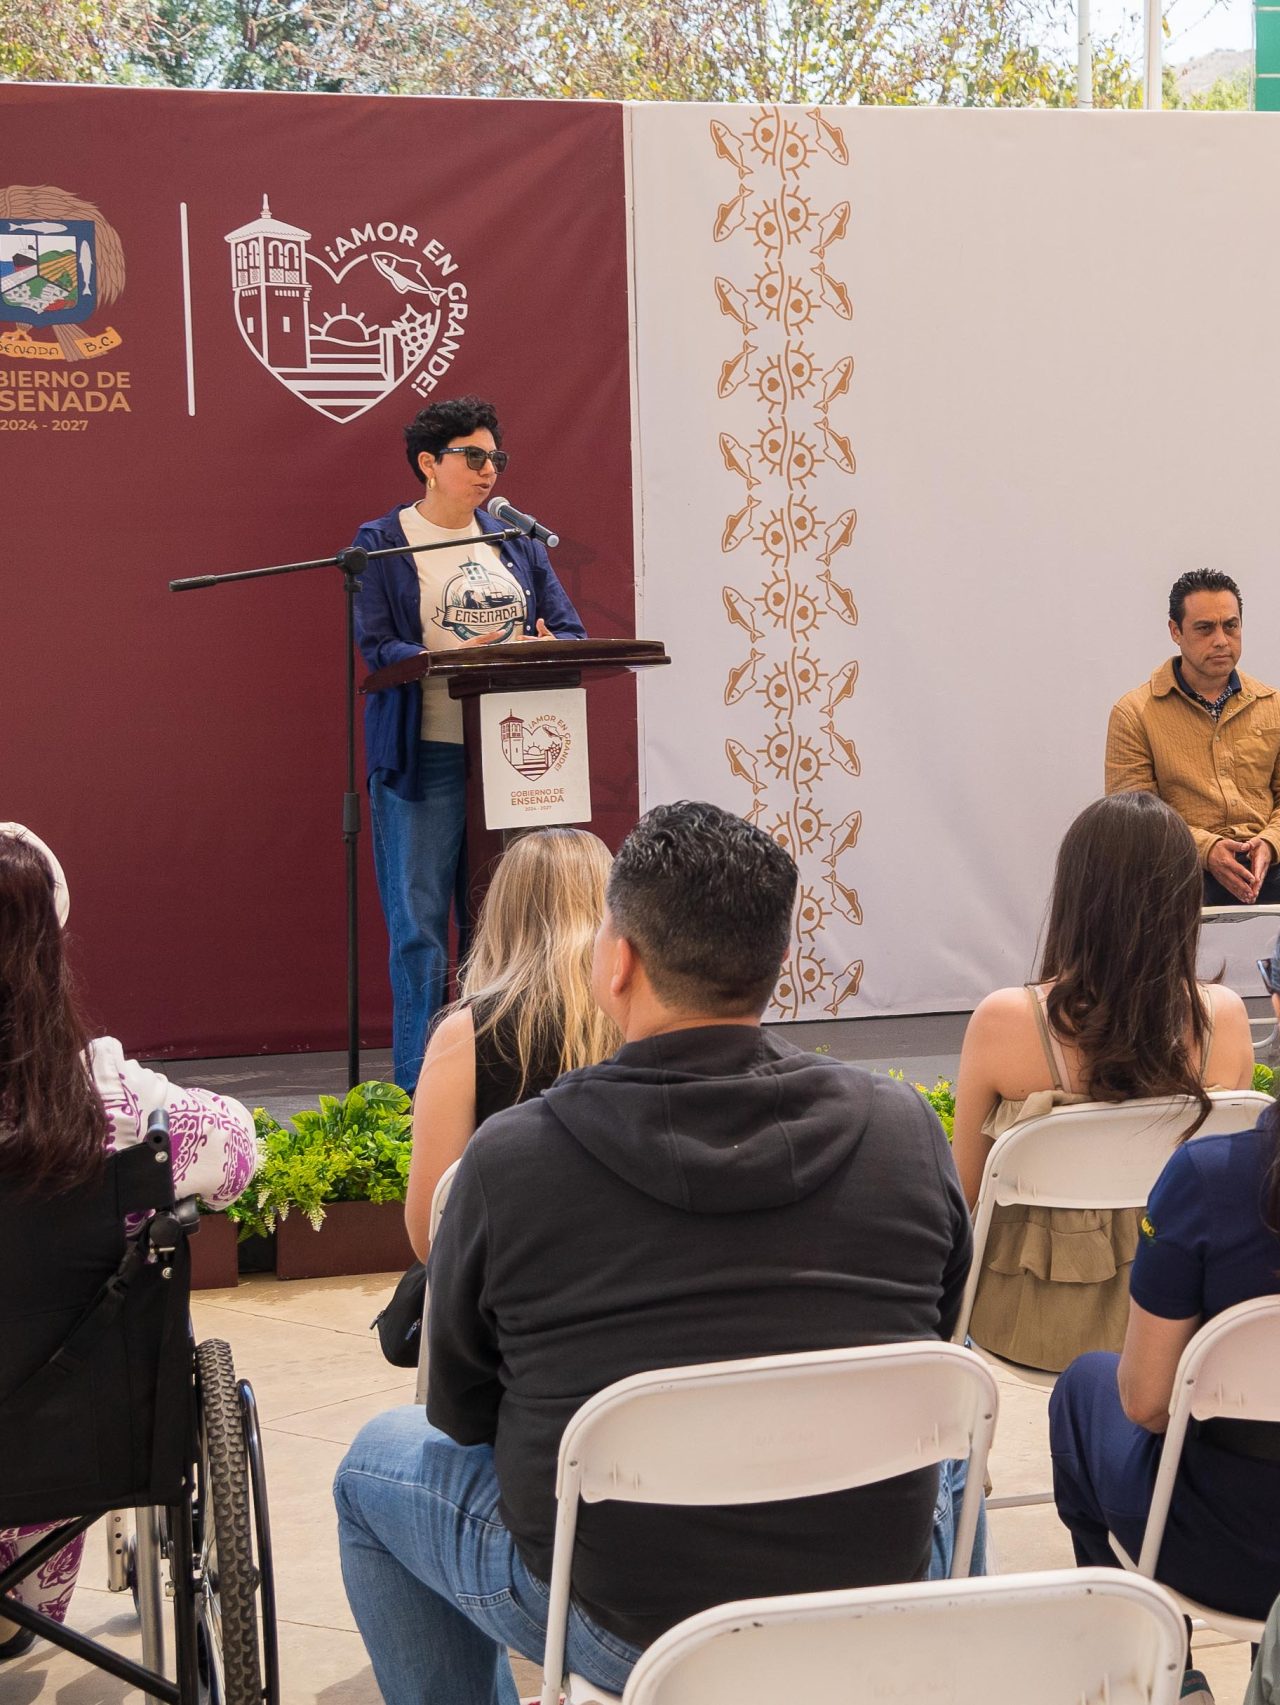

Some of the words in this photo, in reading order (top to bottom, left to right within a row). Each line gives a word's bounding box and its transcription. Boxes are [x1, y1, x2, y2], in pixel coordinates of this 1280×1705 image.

[324, 222, 418, 263] ¡AMOR
[422, 238, 459, 277] EN
[0, 343, 59, 356] ENADA
[84, 336, 114, 352] B.C.
[410, 282, 468, 398] GRANDE!
[97, 371, 131, 388] DE
[0, 390, 132, 412] SENADA
[0, 419, 38, 431] 2024
[52, 419, 89, 431] 2027
[455, 605, 518, 623] ENSENADA
[557, 719, 568, 731] EN
[510, 789, 552, 798] GOBIERNO
[511, 795, 565, 806] ENSENADA
